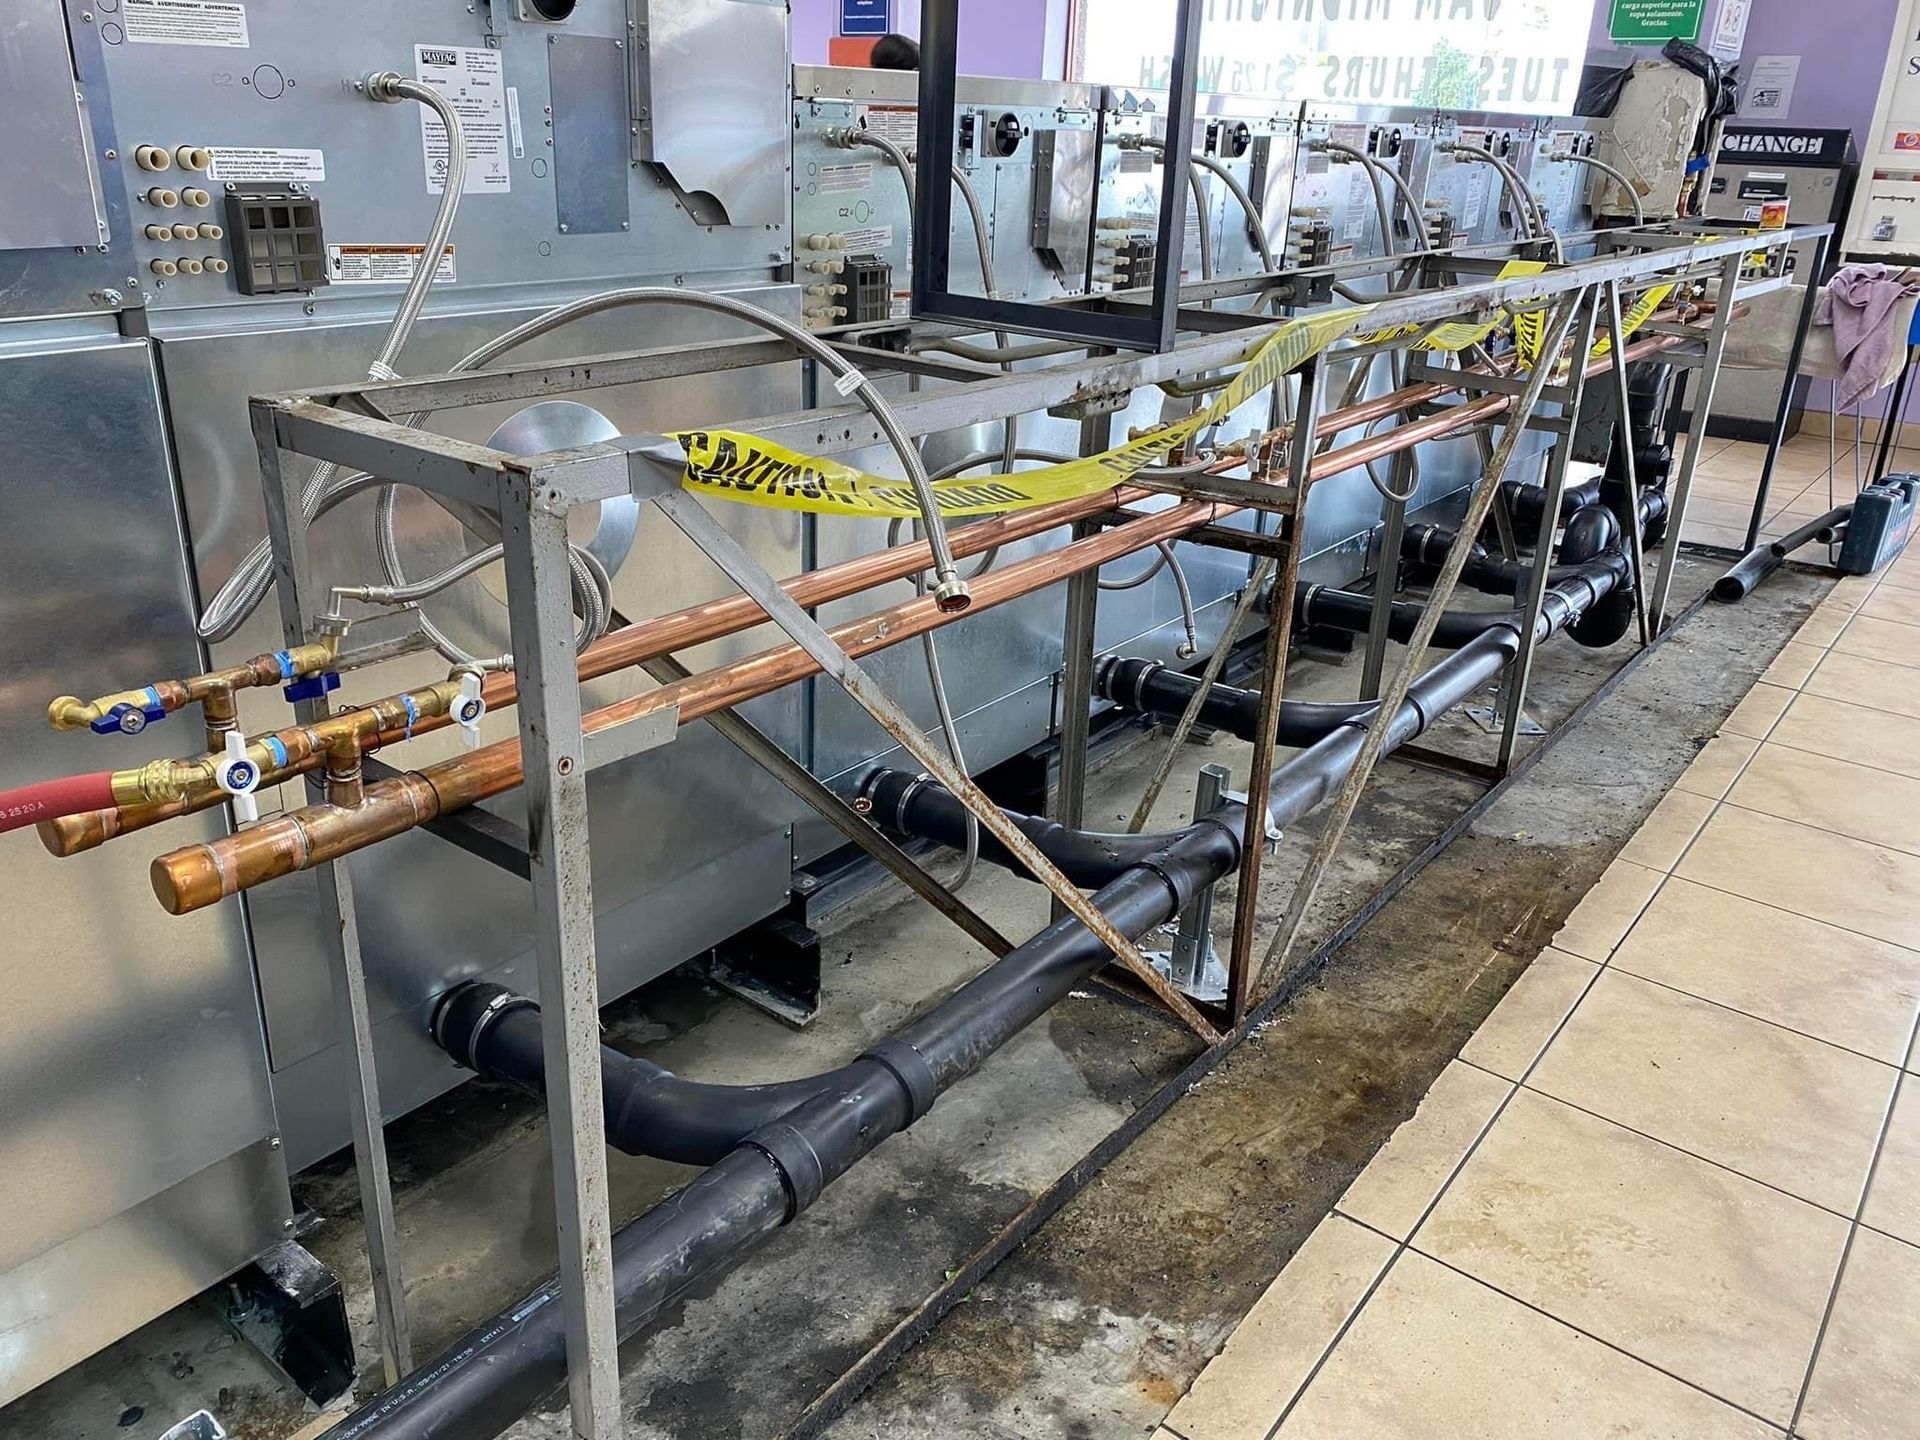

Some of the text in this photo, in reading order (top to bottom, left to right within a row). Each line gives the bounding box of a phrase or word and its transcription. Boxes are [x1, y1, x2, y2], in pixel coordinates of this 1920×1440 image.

[1640, 2, 1671, 10] superior
[1641, 19, 1670, 27] Gracias.
[422, 51, 456, 62] MAYTAG
[211, 72, 233, 87] C2
[1722, 134, 1824, 155] CHANGE
